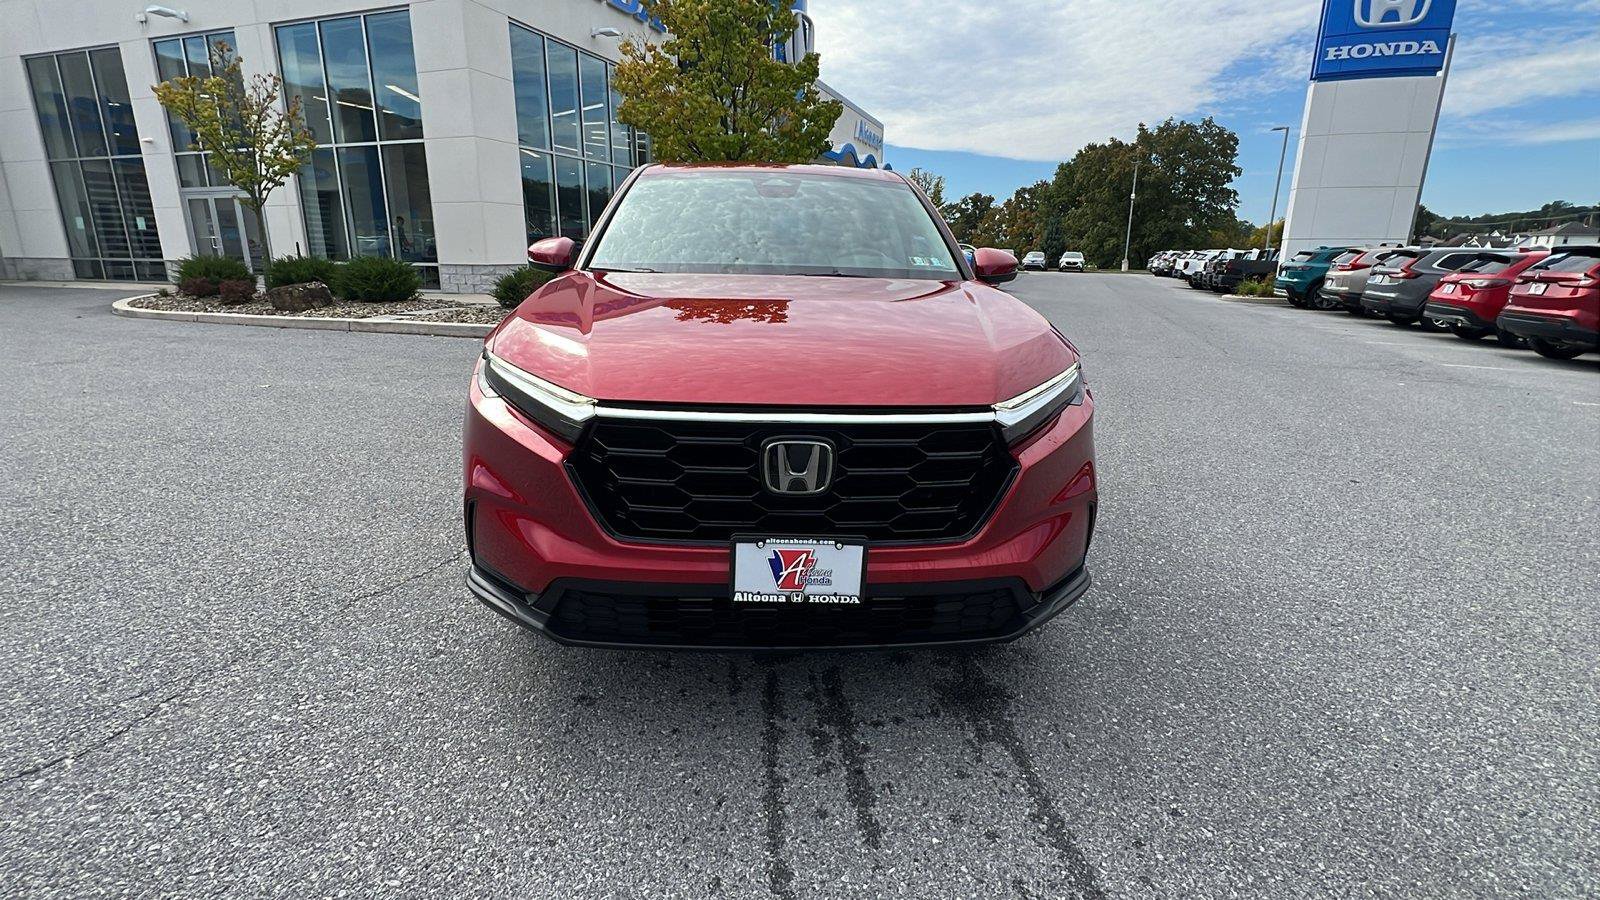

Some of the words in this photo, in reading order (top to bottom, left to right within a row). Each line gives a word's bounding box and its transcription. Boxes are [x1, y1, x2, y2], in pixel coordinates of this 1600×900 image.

[1325, 40, 1441, 61] HONDA
[800, 575, 831, 584] Honda
[734, 592, 786, 602] Altoona
[809, 595, 860, 603] HONDA
